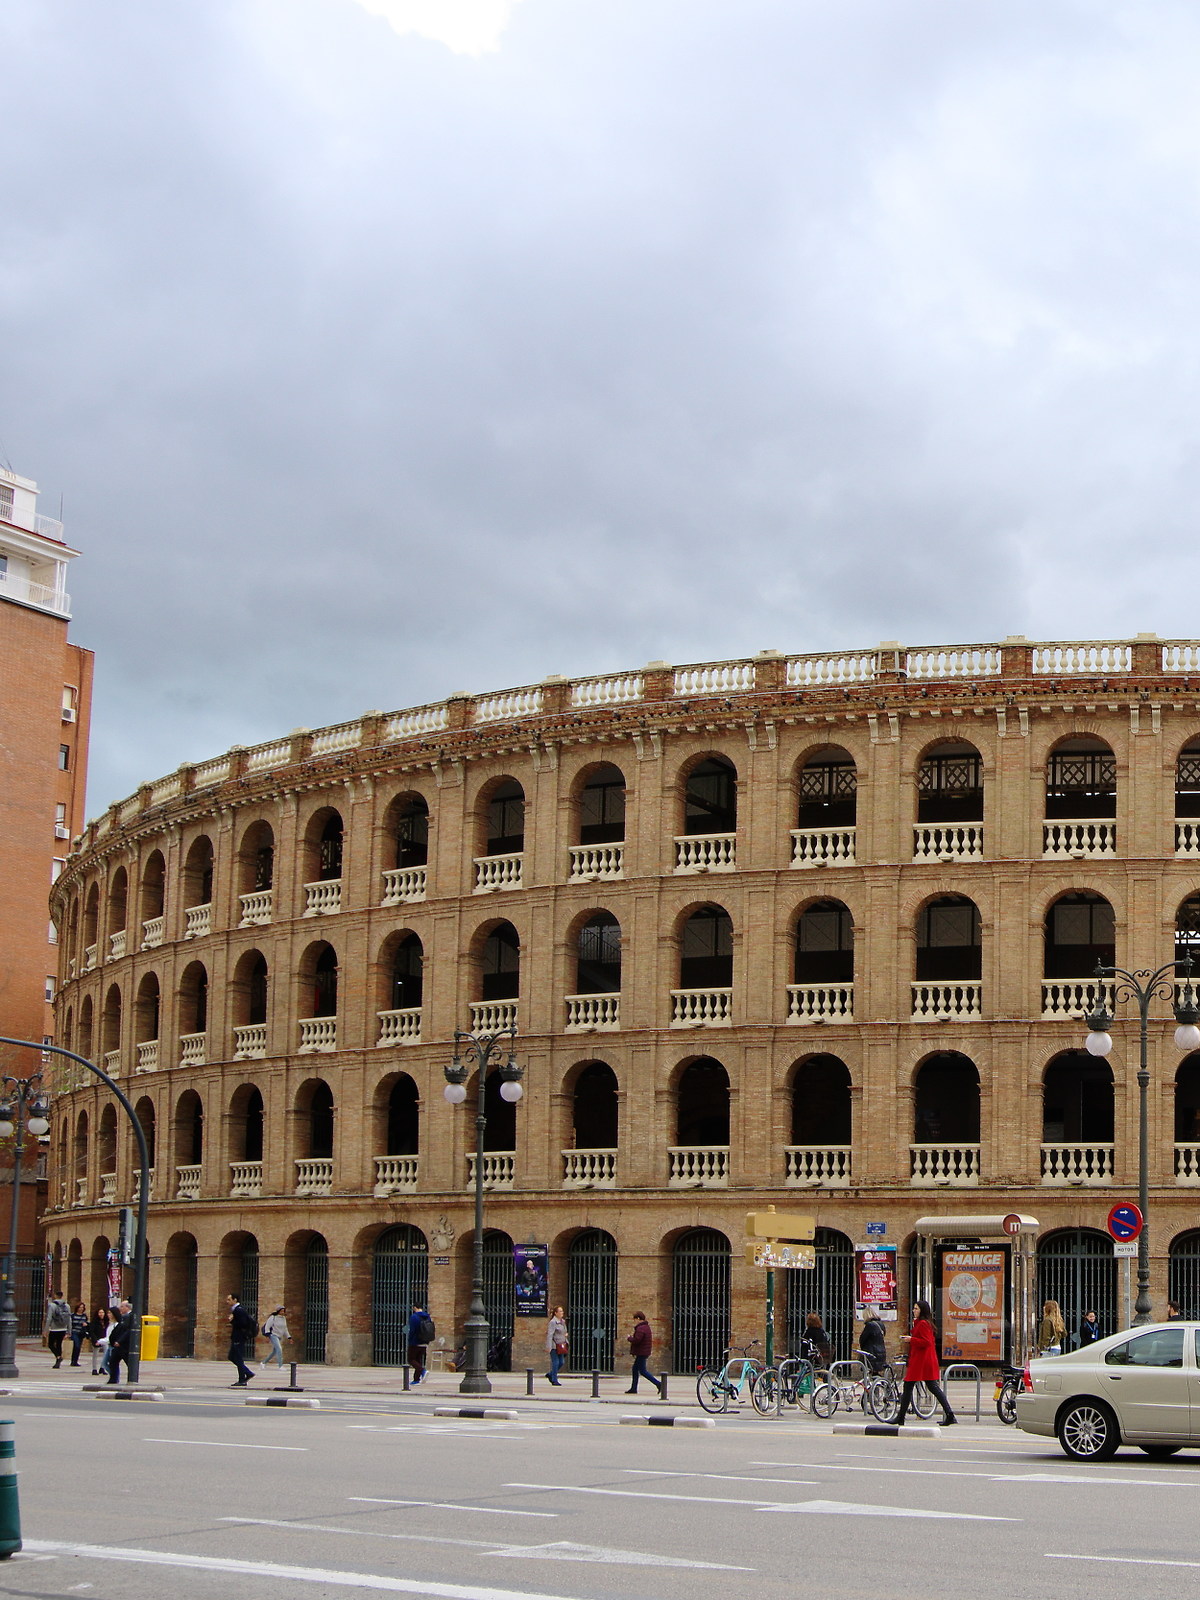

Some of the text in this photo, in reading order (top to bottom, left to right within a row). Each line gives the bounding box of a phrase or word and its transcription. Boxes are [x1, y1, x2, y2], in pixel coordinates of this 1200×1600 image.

[1010, 1223, 1020, 1232] m
[946, 1254, 1001, 1264] CHANGE
[944, 1345, 962, 1356] Ria
